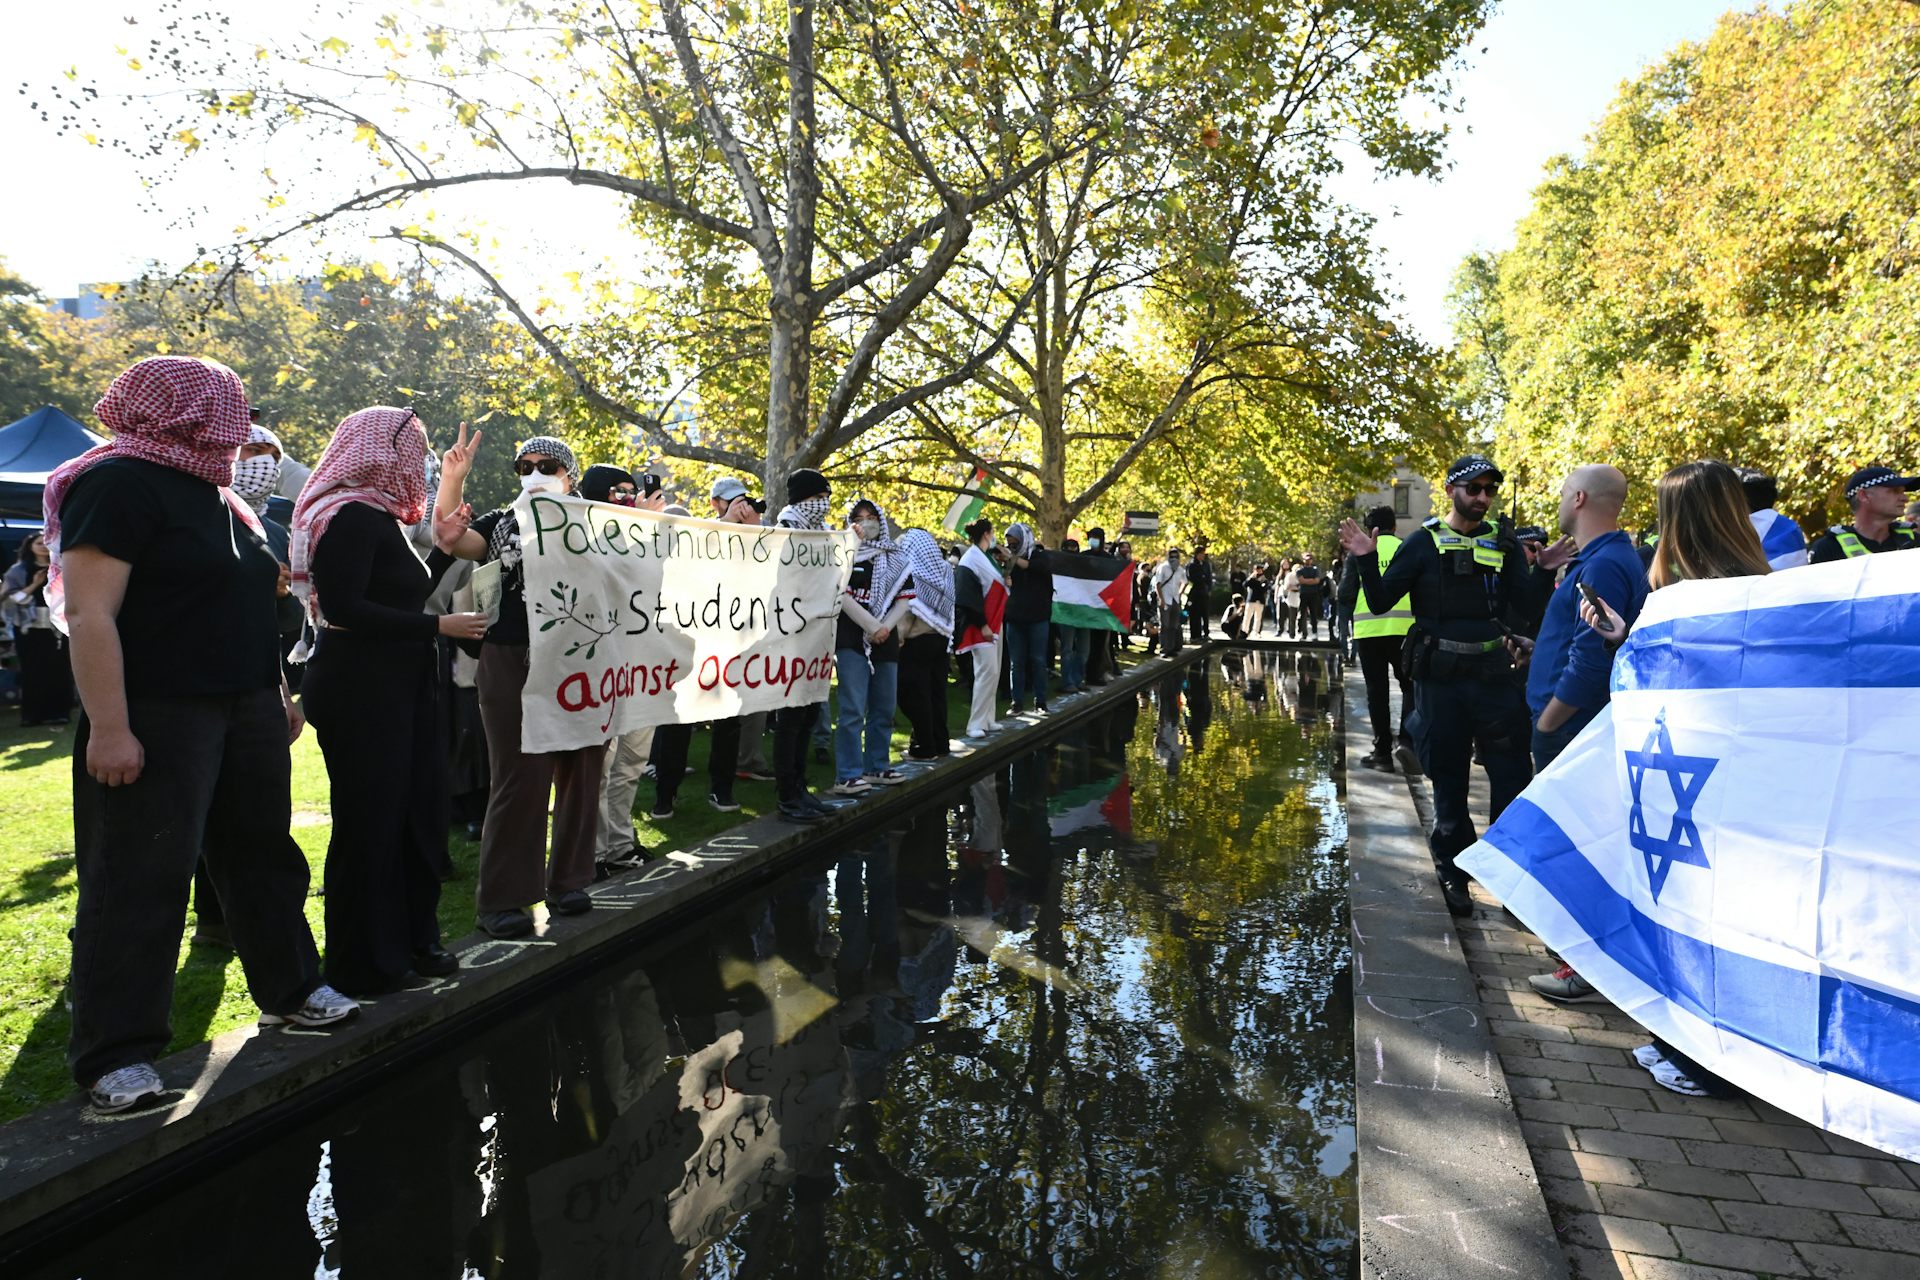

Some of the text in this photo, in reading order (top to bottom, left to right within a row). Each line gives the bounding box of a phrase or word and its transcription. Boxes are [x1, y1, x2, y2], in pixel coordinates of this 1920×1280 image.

[530, 497, 855, 568] Palestinian & Jewish
[626, 583, 807, 635] Students
[557, 659, 680, 733] against
